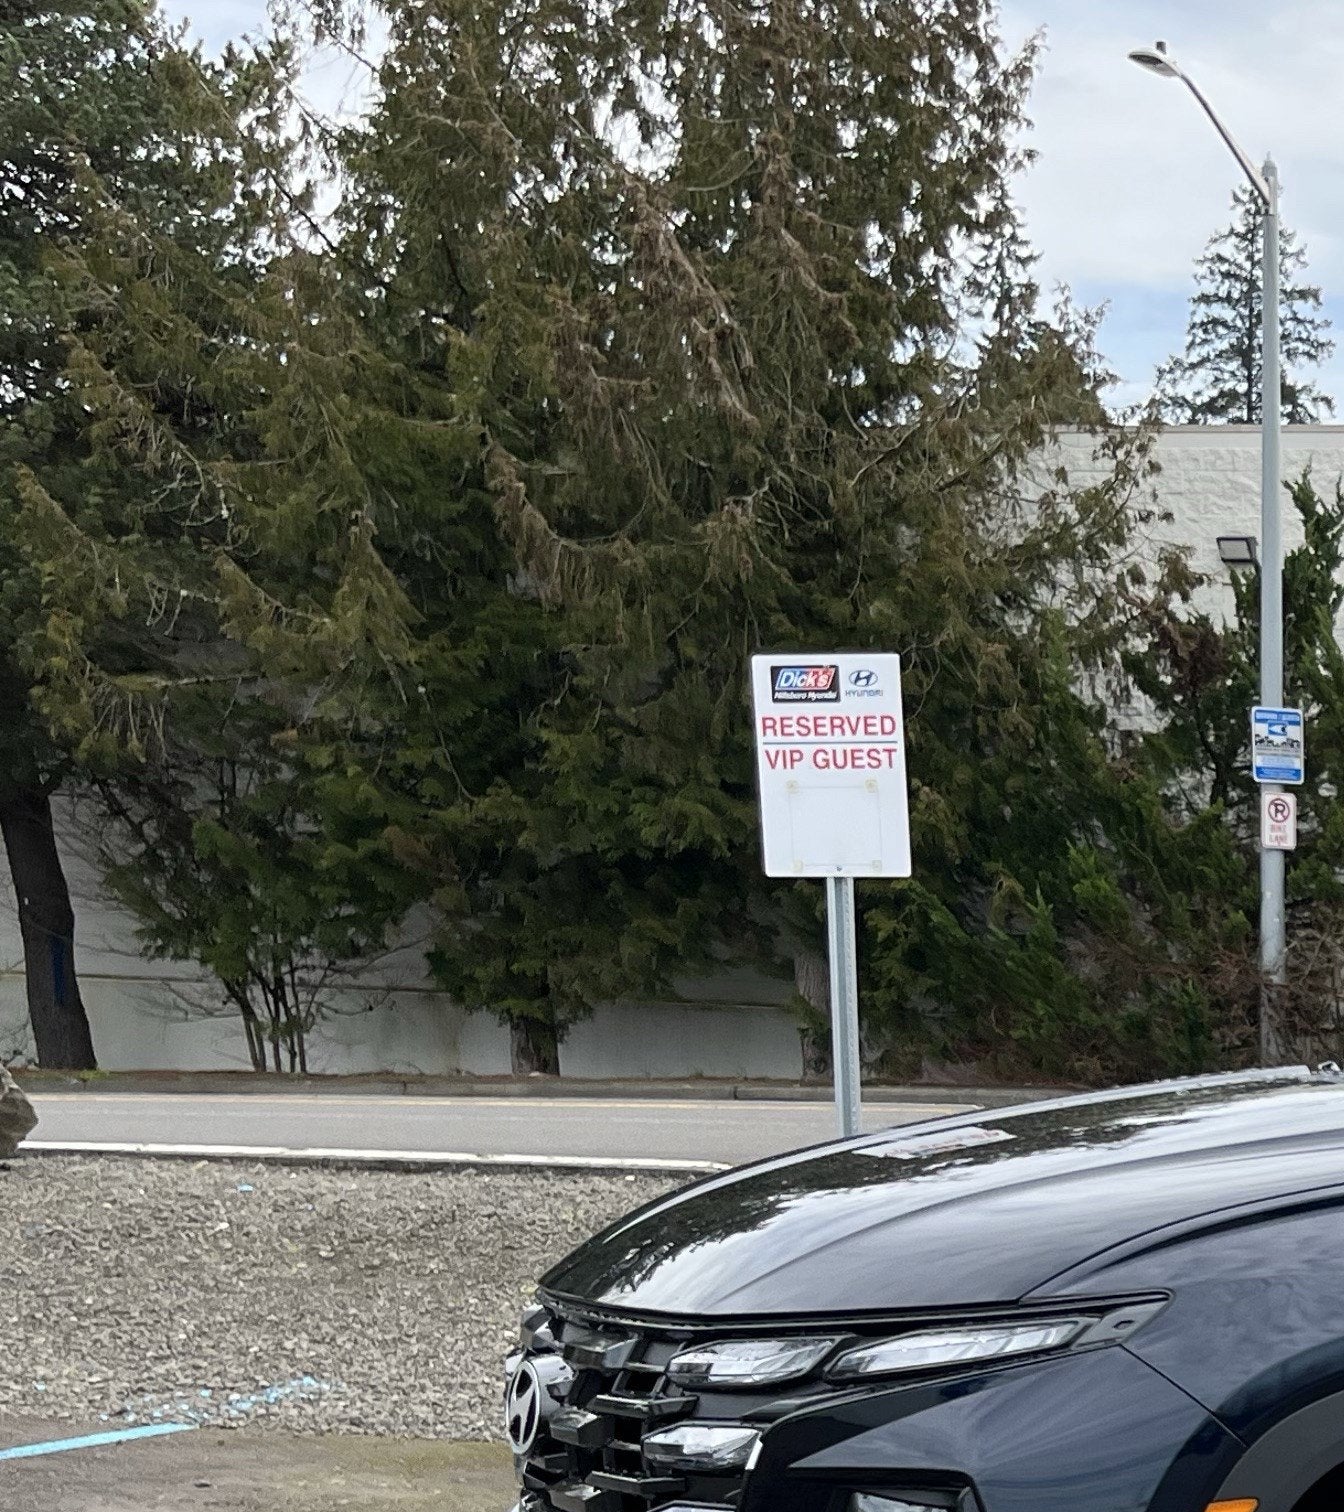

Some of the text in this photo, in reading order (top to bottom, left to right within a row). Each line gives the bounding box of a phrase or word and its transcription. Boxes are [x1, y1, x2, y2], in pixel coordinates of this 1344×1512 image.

[779, 669, 829, 688] Dick's
[761, 715, 897, 737] RESERVED
[764, 748, 898, 770] VIP GUEST
